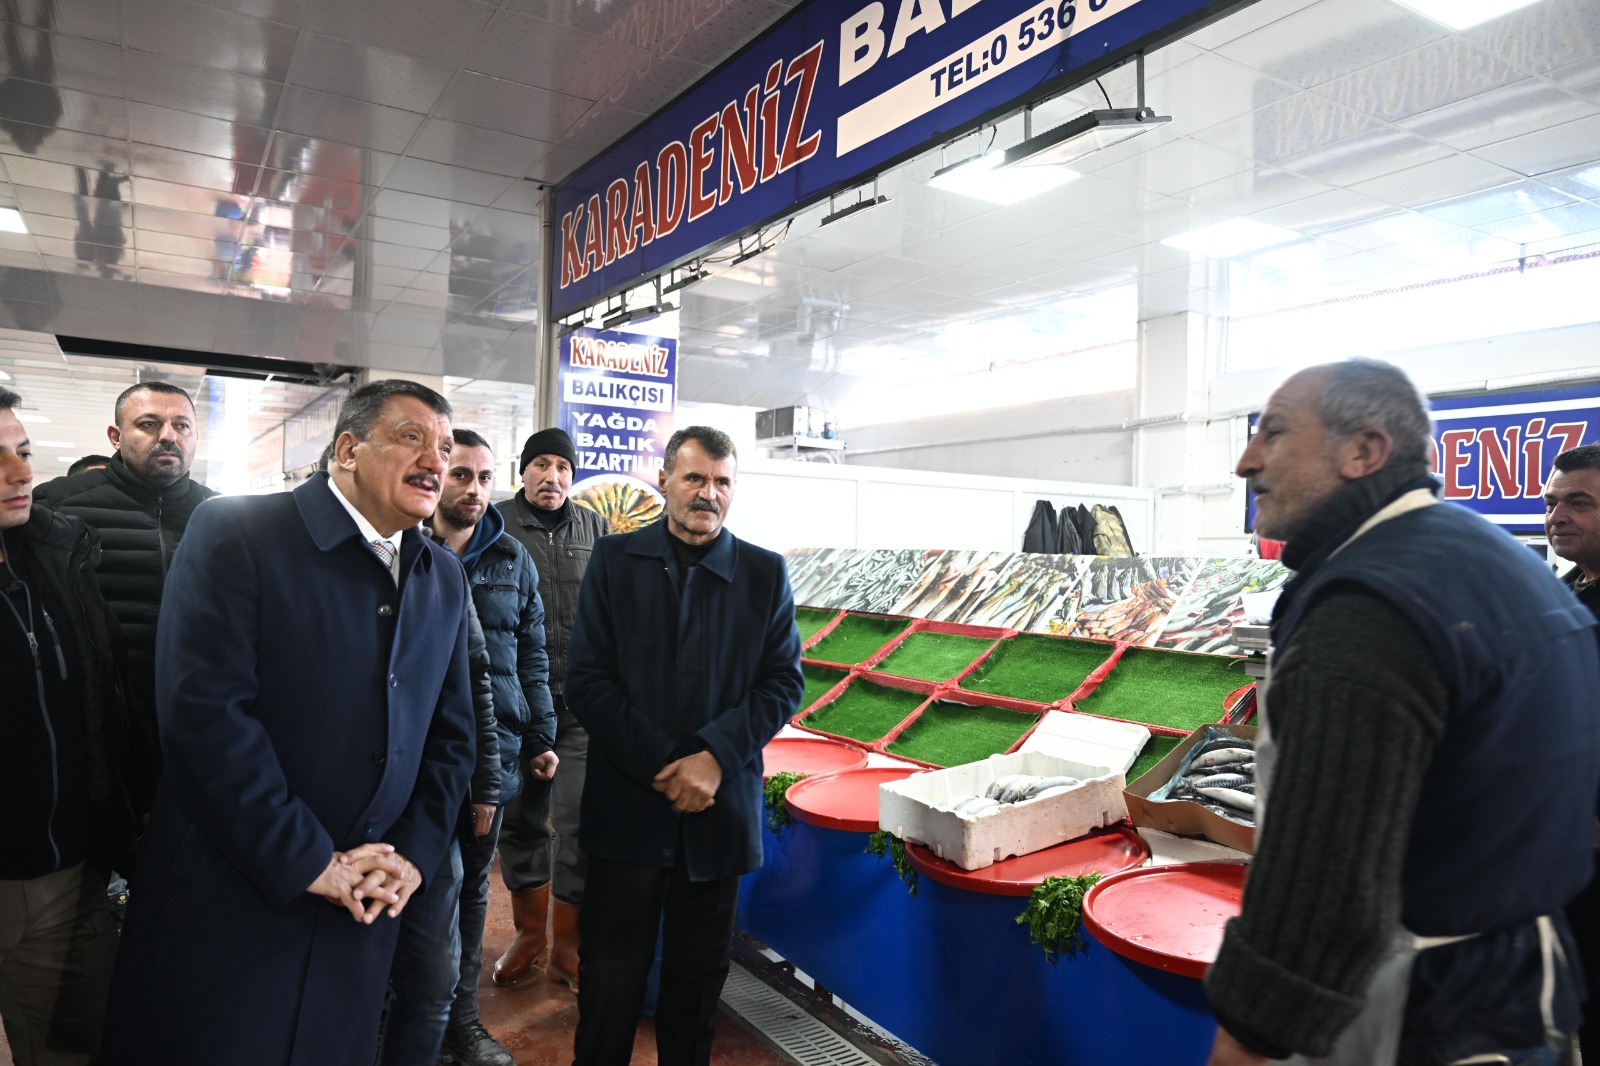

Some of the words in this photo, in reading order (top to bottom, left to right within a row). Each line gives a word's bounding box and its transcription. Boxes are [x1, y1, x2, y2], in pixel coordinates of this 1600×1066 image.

[838, 0, 982, 87] BA
[930, 34, 1007, 98] TEL:0
[1017, 0, 1075, 52] 536
[572, 379, 664, 405] BALIKÇISI
[572, 411, 660, 432] YAĞDA
[576, 432, 656, 452] BALIK
[575, 451, 665, 472] IZARTILIR
[1429, 418, 1588, 500] ENİZ
